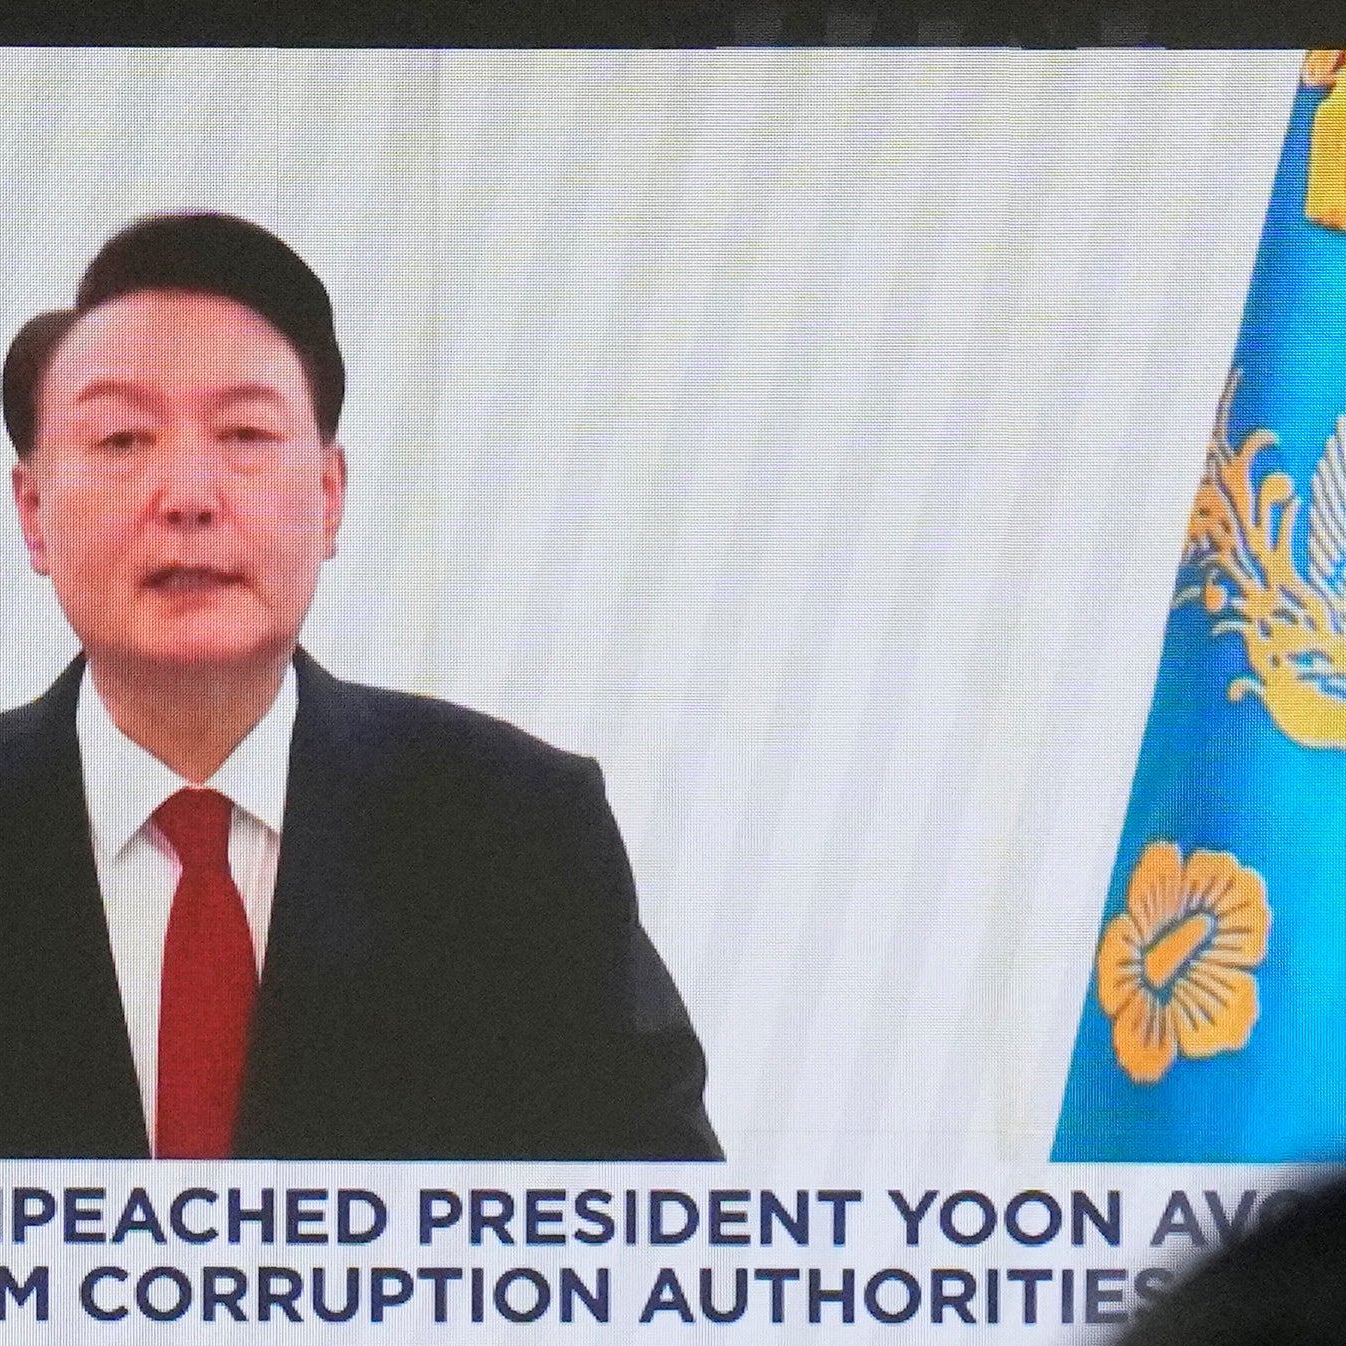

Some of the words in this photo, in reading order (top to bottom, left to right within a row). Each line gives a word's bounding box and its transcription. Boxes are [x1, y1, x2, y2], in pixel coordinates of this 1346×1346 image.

[419, 1189, 863, 1246] PRESIDENT
[889, 1190, 1121, 1247] YOON
[79, 1266, 610, 1324] CORRUPTION
